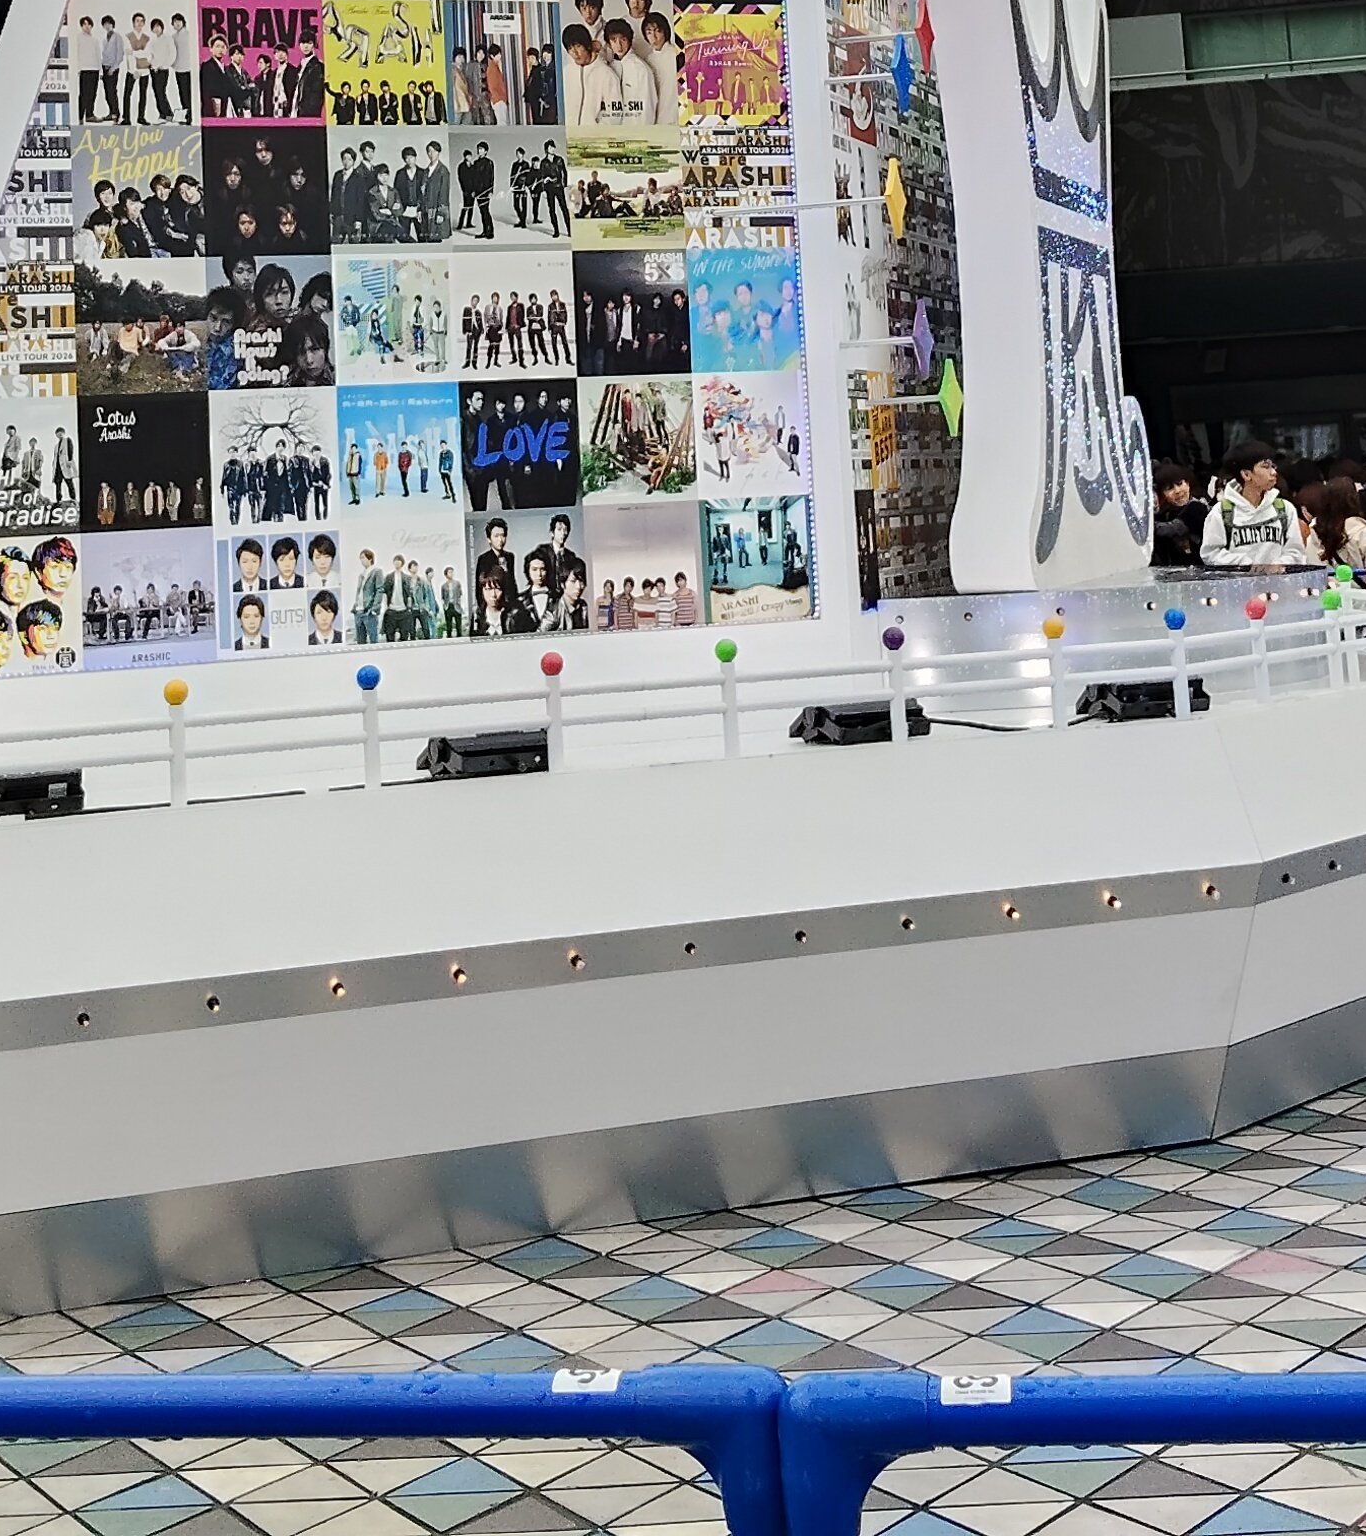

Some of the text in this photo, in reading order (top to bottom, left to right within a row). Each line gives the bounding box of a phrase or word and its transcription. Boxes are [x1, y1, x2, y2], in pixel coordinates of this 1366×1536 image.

[202, 7, 319, 49] BRAVE
[685, 31, 770, 62] Turning Up
[72, 126, 165, 159] Are You
[20, 149, 69, 157] TOUR 2026
[89, 132, 202, 186] Happy?
[681, 150, 747, 166] We are
[683, 166, 786, 187] ARASHI
[21, 216, 46, 224] TOUR
[48, 216, 70, 224] 2026
[684, 211, 713, 227] We
[723, 216, 750, 227] are
[686, 227, 793, 250] ARASHI
[644, 252, 683, 263] ARASHI
[7, 271, 72, 283] ARASHI
[0, 285, 20, 293] LIVE
[23, 284, 47, 293] TOUR
[49, 284, 73, 292] 2026
[234, 328, 283, 346] Arashi
[1, 354, 20, 362] LIVE
[24, 353, 48, 361] TOUR
[51, 352, 73, 360] 2026
[238, 365, 290, 385] going?
[92, 406, 136, 427] Lotus
[99, 428, 132, 442] Arashi
[473, 421, 571, 467] LOVE
[721, 595, 759, 611] ARASHI
[131, 651, 172, 662] ARASHIC
